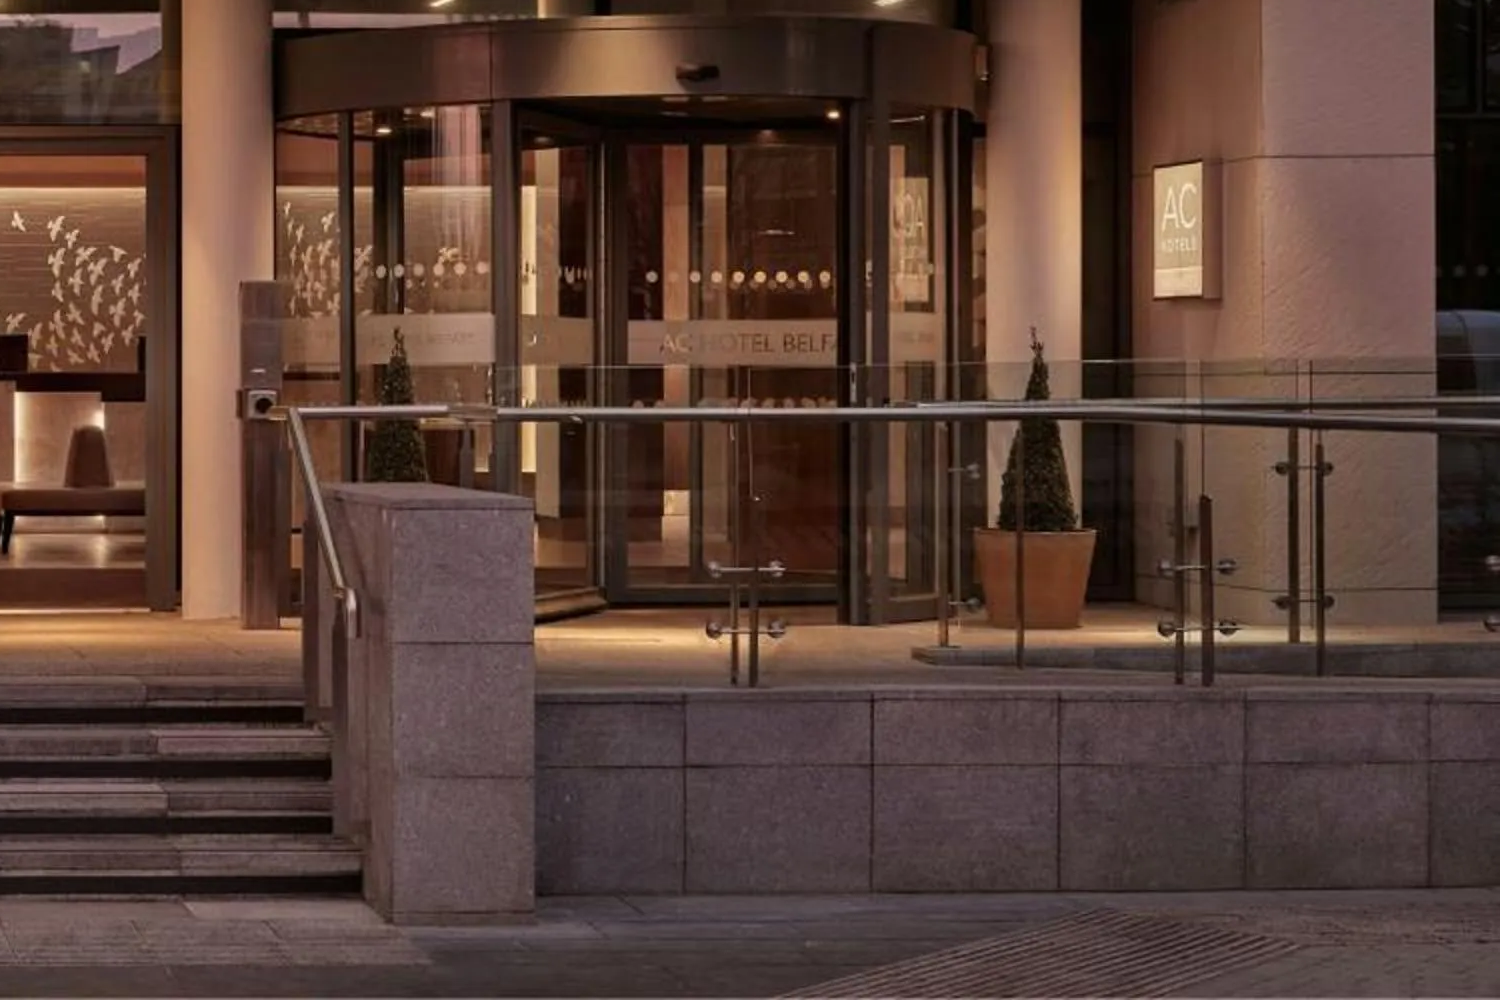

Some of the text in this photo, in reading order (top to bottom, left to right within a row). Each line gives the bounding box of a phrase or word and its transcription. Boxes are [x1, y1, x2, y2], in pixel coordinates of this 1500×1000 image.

[1161, 182, 1197, 232] AC
[660, 333, 693, 354] AC
[782, 333, 837, 353] BELF
